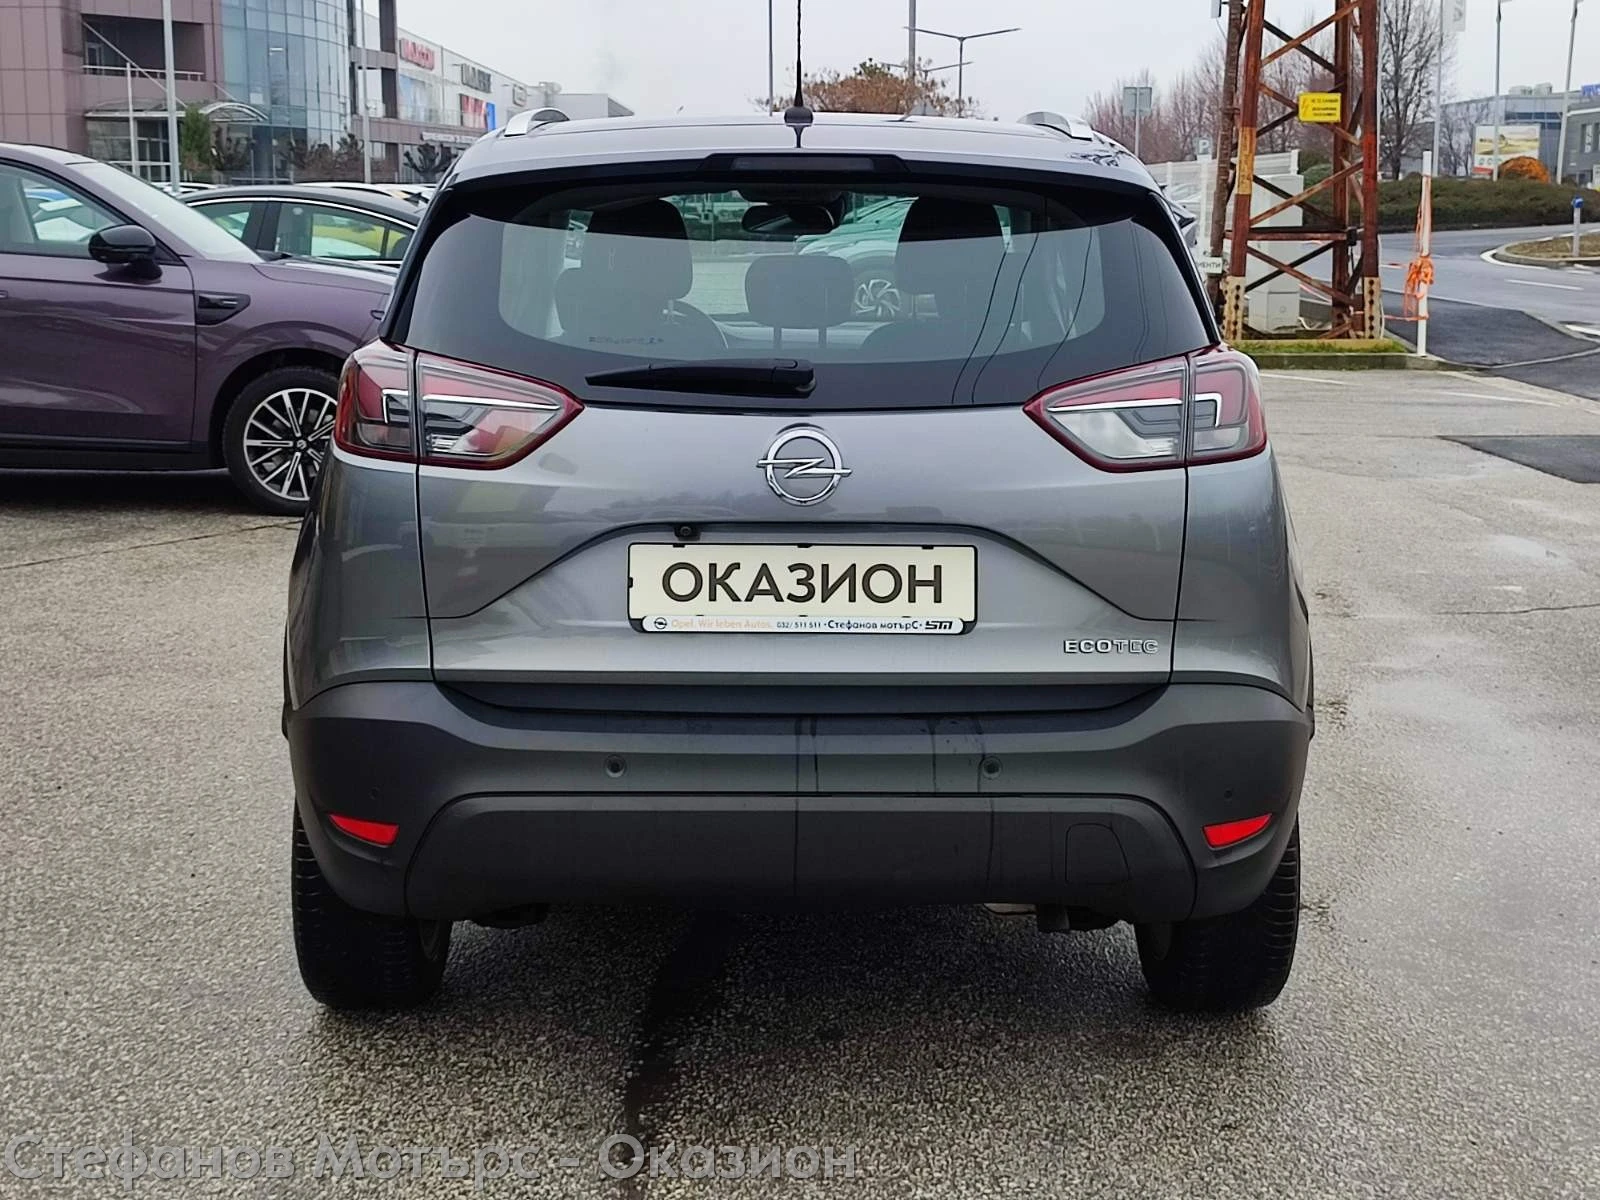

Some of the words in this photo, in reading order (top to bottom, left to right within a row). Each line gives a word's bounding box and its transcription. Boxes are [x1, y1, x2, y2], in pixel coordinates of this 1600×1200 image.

[1199, 139, 1209, 154] P
[661, 562, 942, 604] ОКАЗИОН
[1063, 639, 1158, 654] ECOTEC
